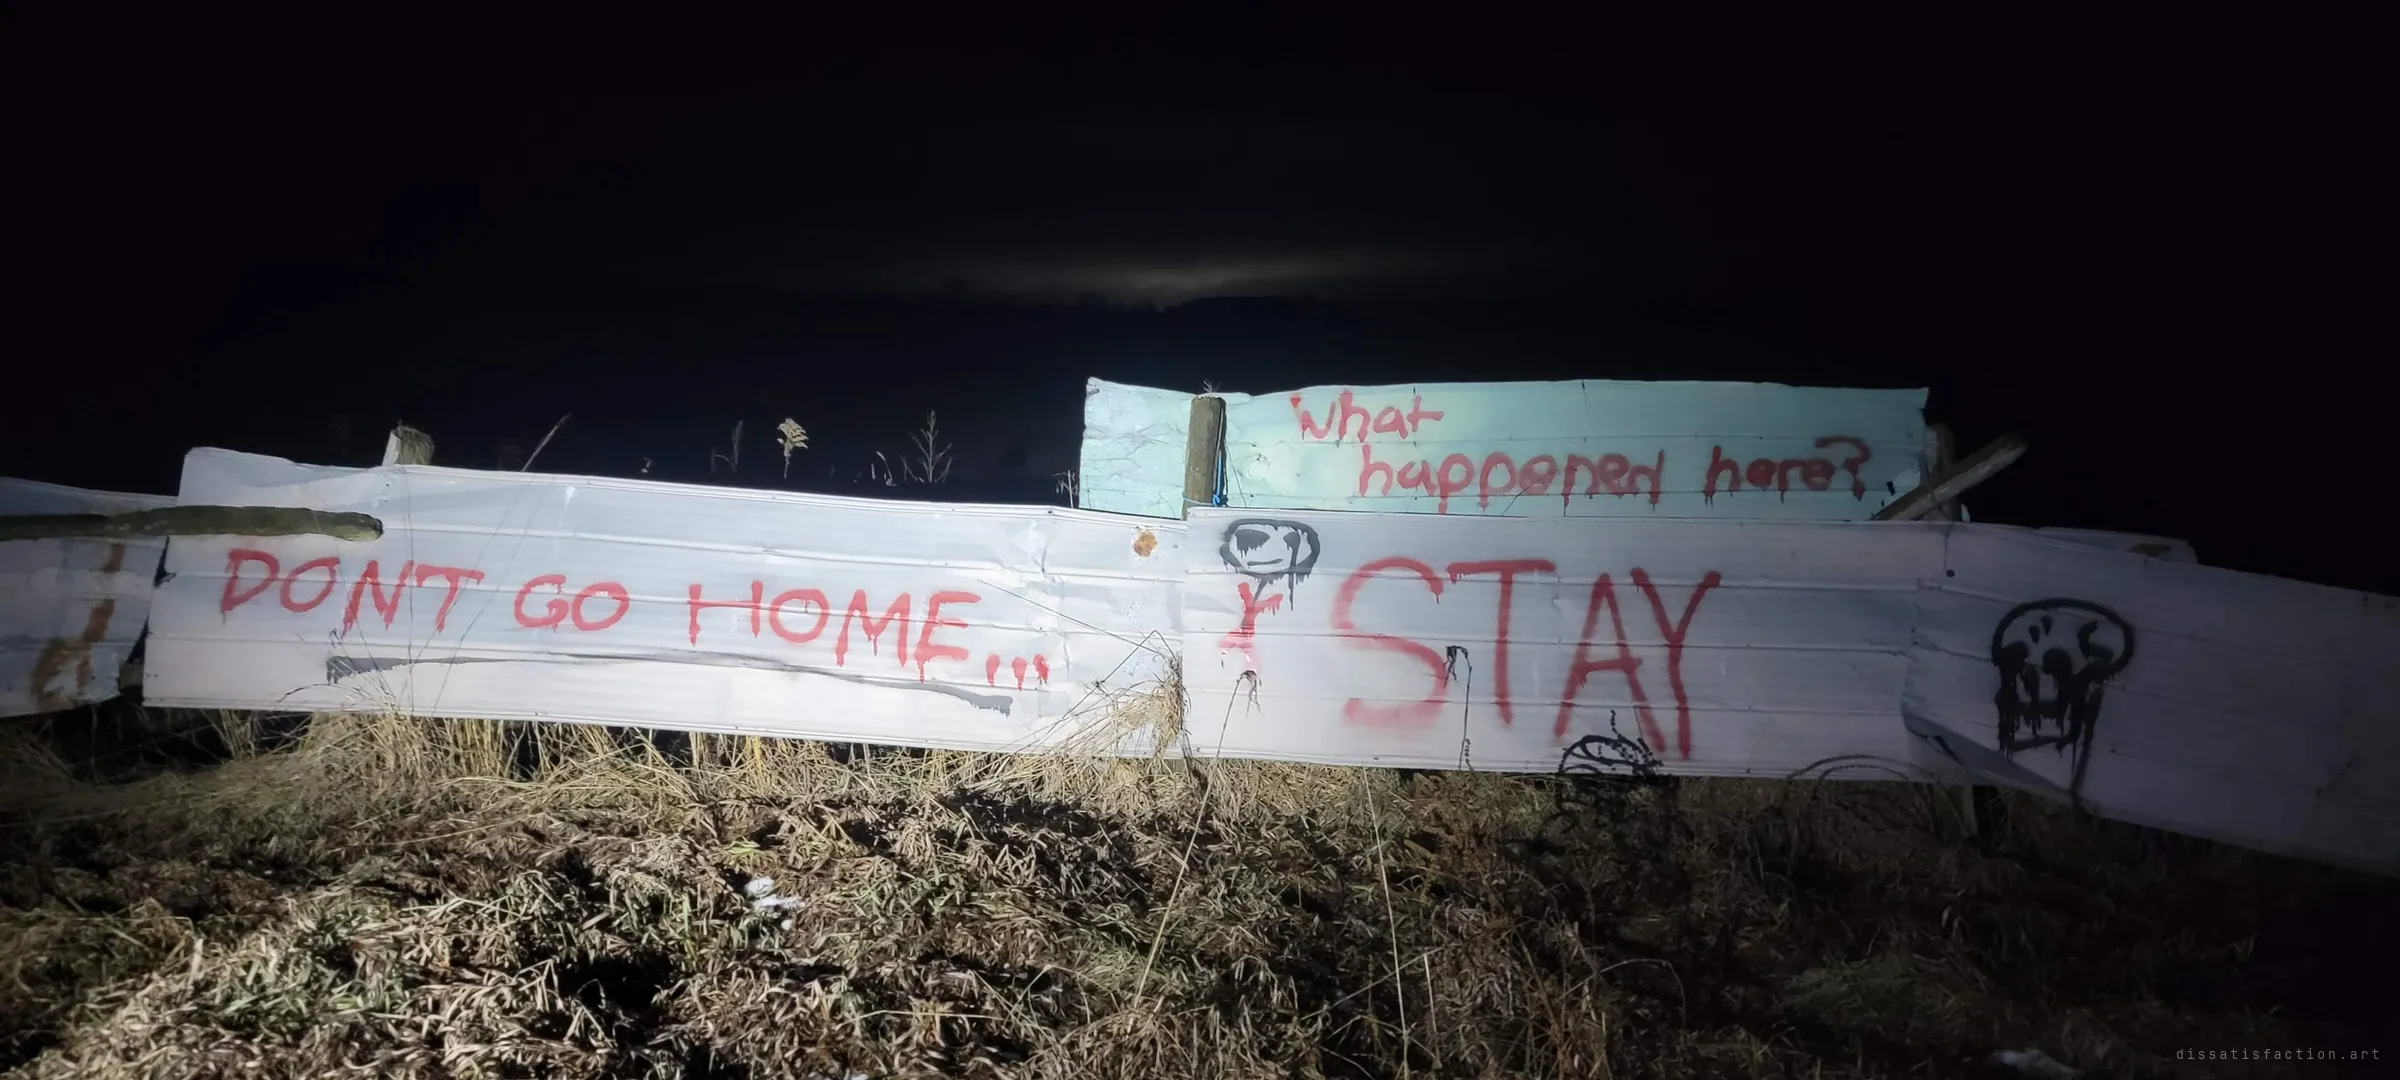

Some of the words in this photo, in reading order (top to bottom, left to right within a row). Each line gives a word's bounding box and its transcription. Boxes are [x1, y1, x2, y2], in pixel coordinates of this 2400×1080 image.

[1357, 443, 1664, 515] happened
[1703, 434, 1872, 505] here?
[513, 574, 631, 632] GO
[1330, 555, 1722, 762] STAY
